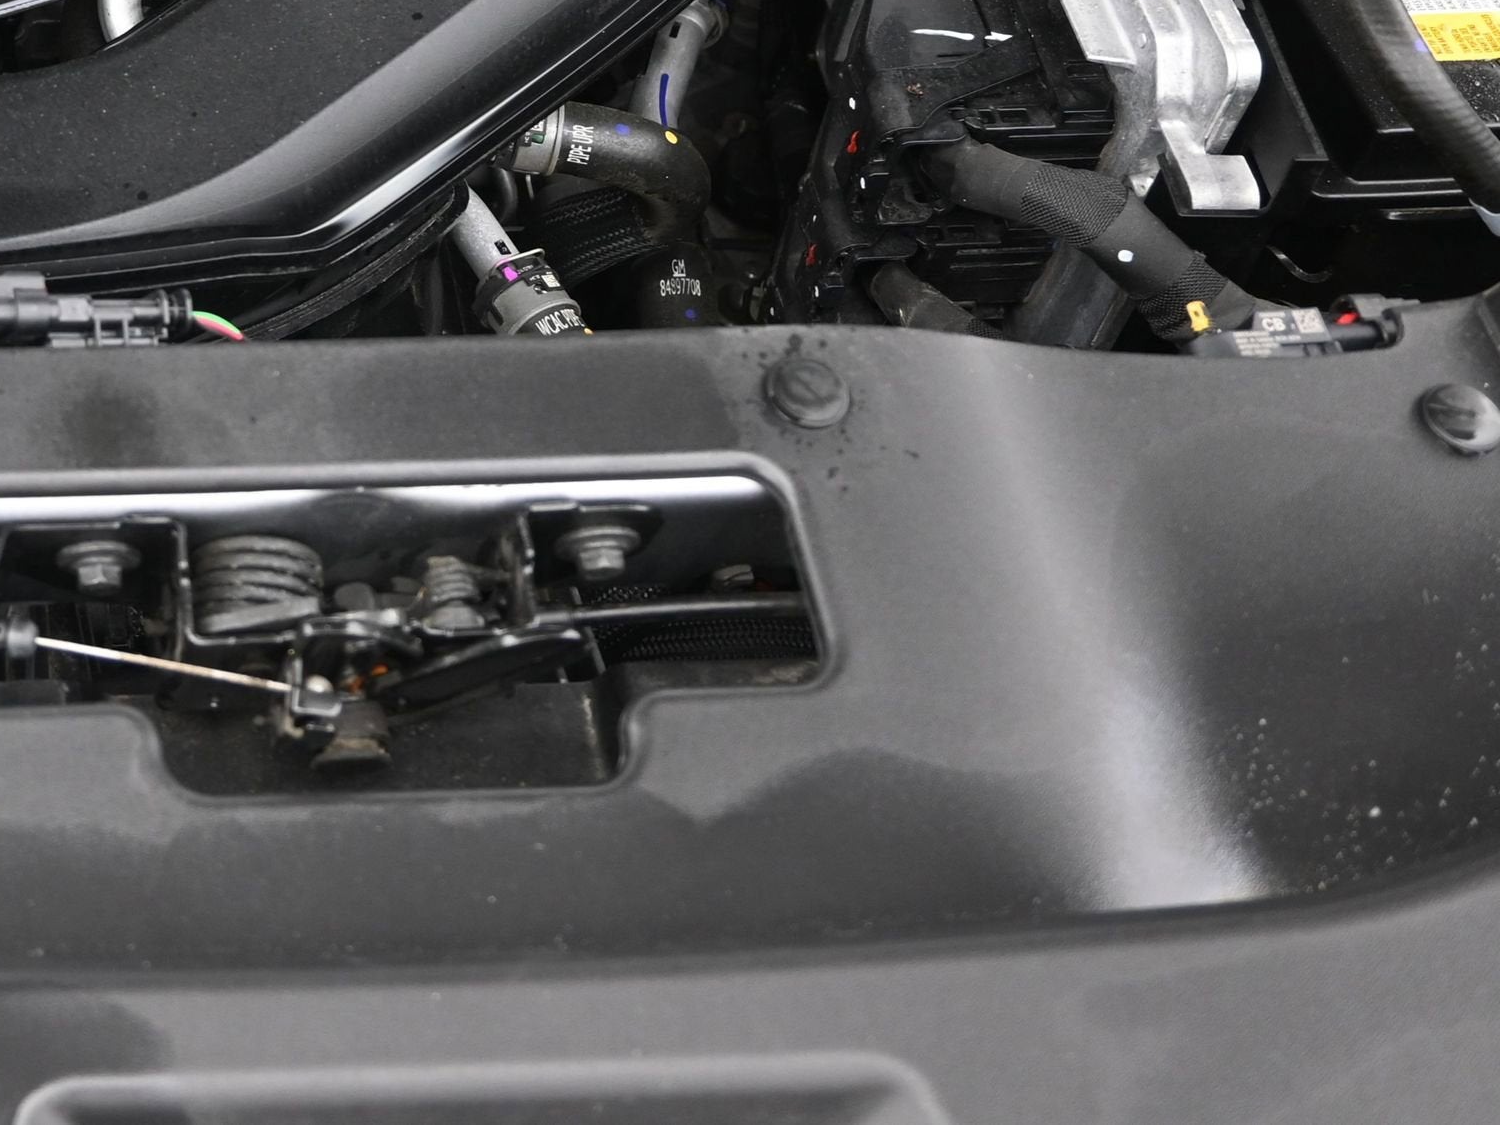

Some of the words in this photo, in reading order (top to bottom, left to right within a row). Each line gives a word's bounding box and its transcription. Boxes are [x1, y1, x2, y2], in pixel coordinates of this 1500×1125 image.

[572, 124, 594, 144] UPR
[567, 144, 591, 165] PIPE
[671, 259, 686, 275] GM
[535, 312, 569, 335] WCAC
